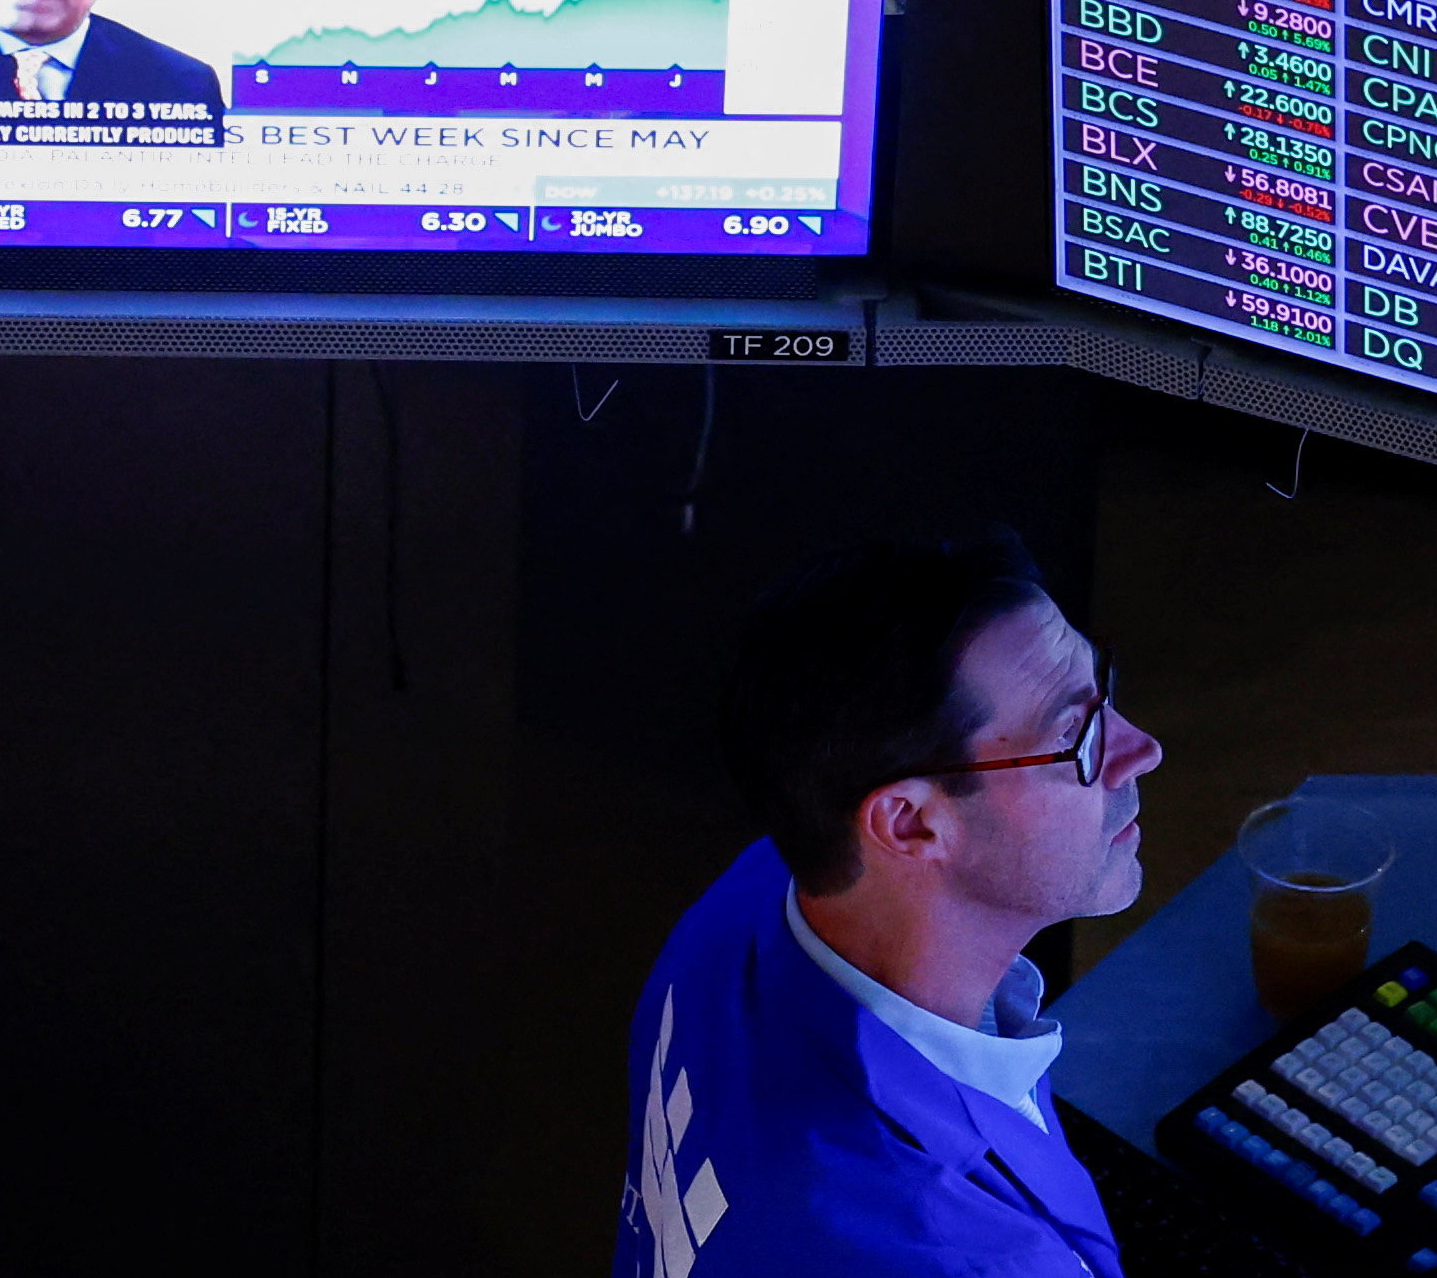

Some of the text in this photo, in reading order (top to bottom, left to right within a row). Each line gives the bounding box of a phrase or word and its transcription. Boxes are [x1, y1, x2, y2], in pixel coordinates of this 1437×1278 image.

[261, 123, 710, 150] BEST WEEK SINCE MAY
[122, 209, 183, 228] 6.77
[571, 211, 631, 226] 30-YR
[723, 216, 789, 236] 6.90
[570, 224, 643, 238] JUMBO
[722, 334, 837, 359] TF 209
